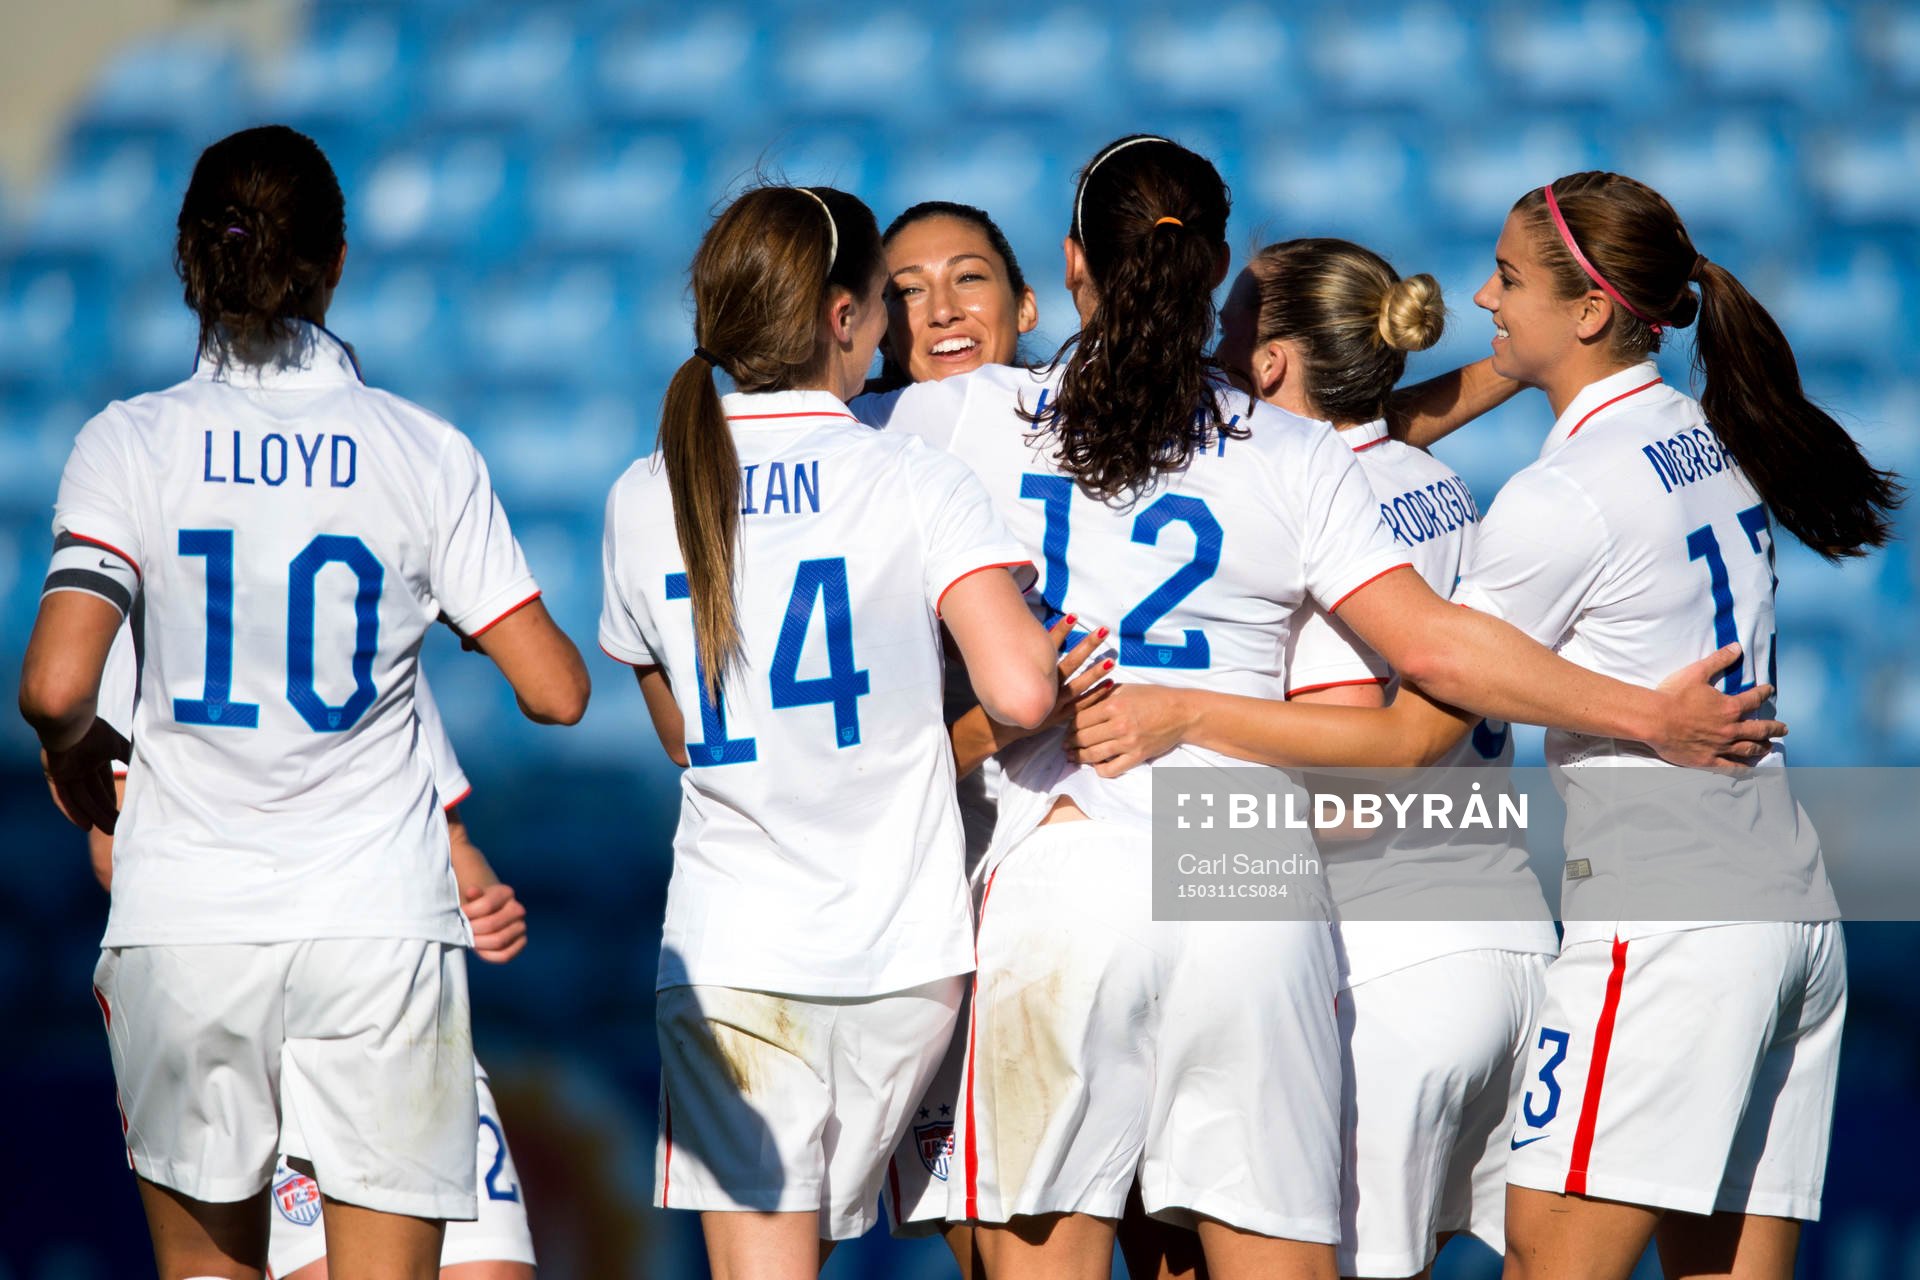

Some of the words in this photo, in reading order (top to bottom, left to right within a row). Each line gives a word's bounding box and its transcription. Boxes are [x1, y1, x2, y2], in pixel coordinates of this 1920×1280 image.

[203, 430, 358, 488] LLOYD
[741, 460, 820, 515] IAN
[1019, 473, 1224, 669] 12
[173, 529, 385, 732] 10
[665, 556, 870, 768] 14
[1523, 1027, 1570, 1129] 3
[479, 1115, 520, 1203] 2
